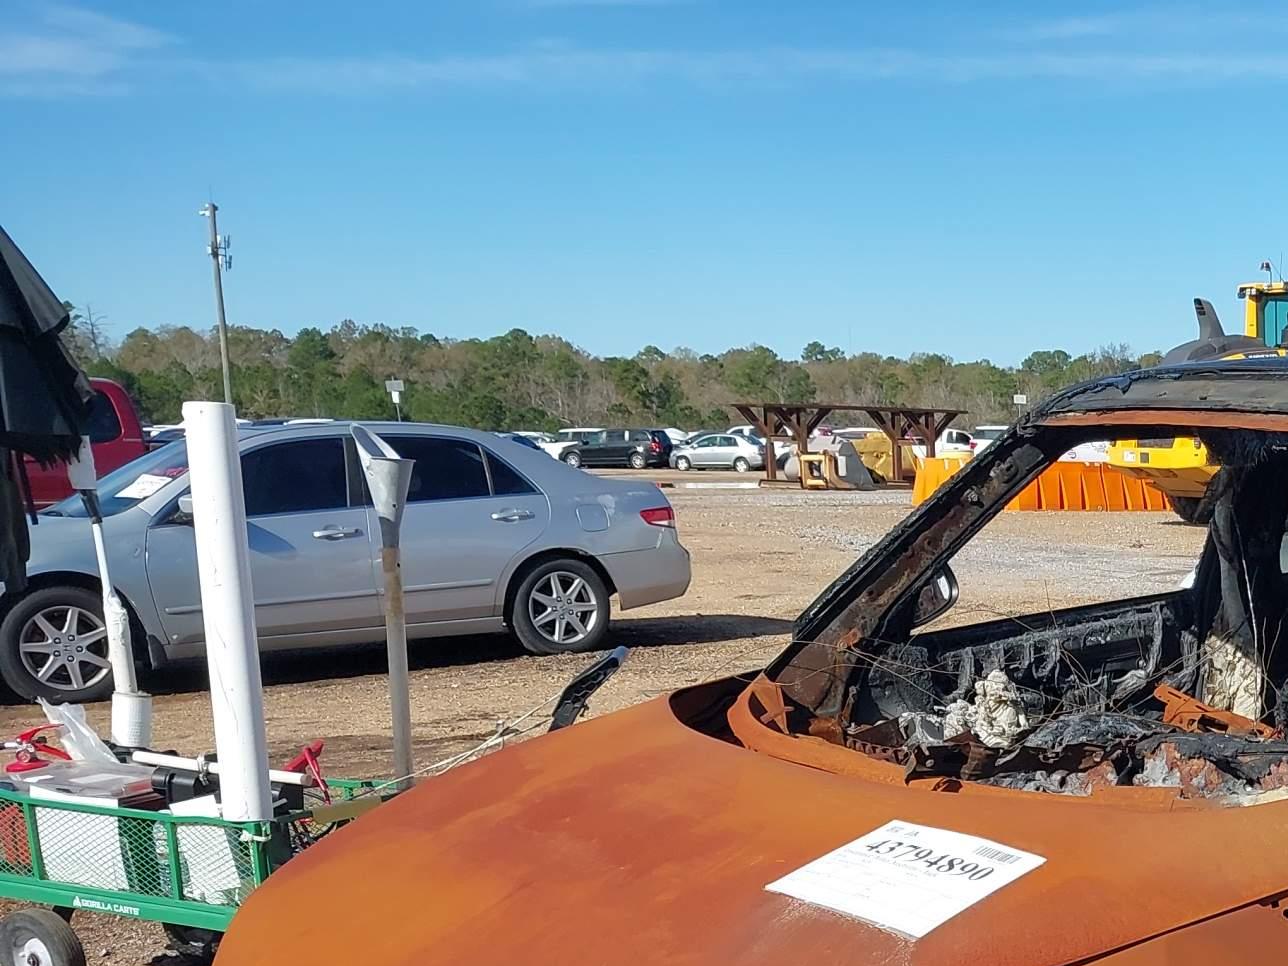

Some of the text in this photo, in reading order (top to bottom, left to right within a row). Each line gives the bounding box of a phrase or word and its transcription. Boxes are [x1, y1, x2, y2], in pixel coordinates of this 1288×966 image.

[866, 839, 995, 881] 43794890
[81, 899, 140, 915] GORILLA CARTS
